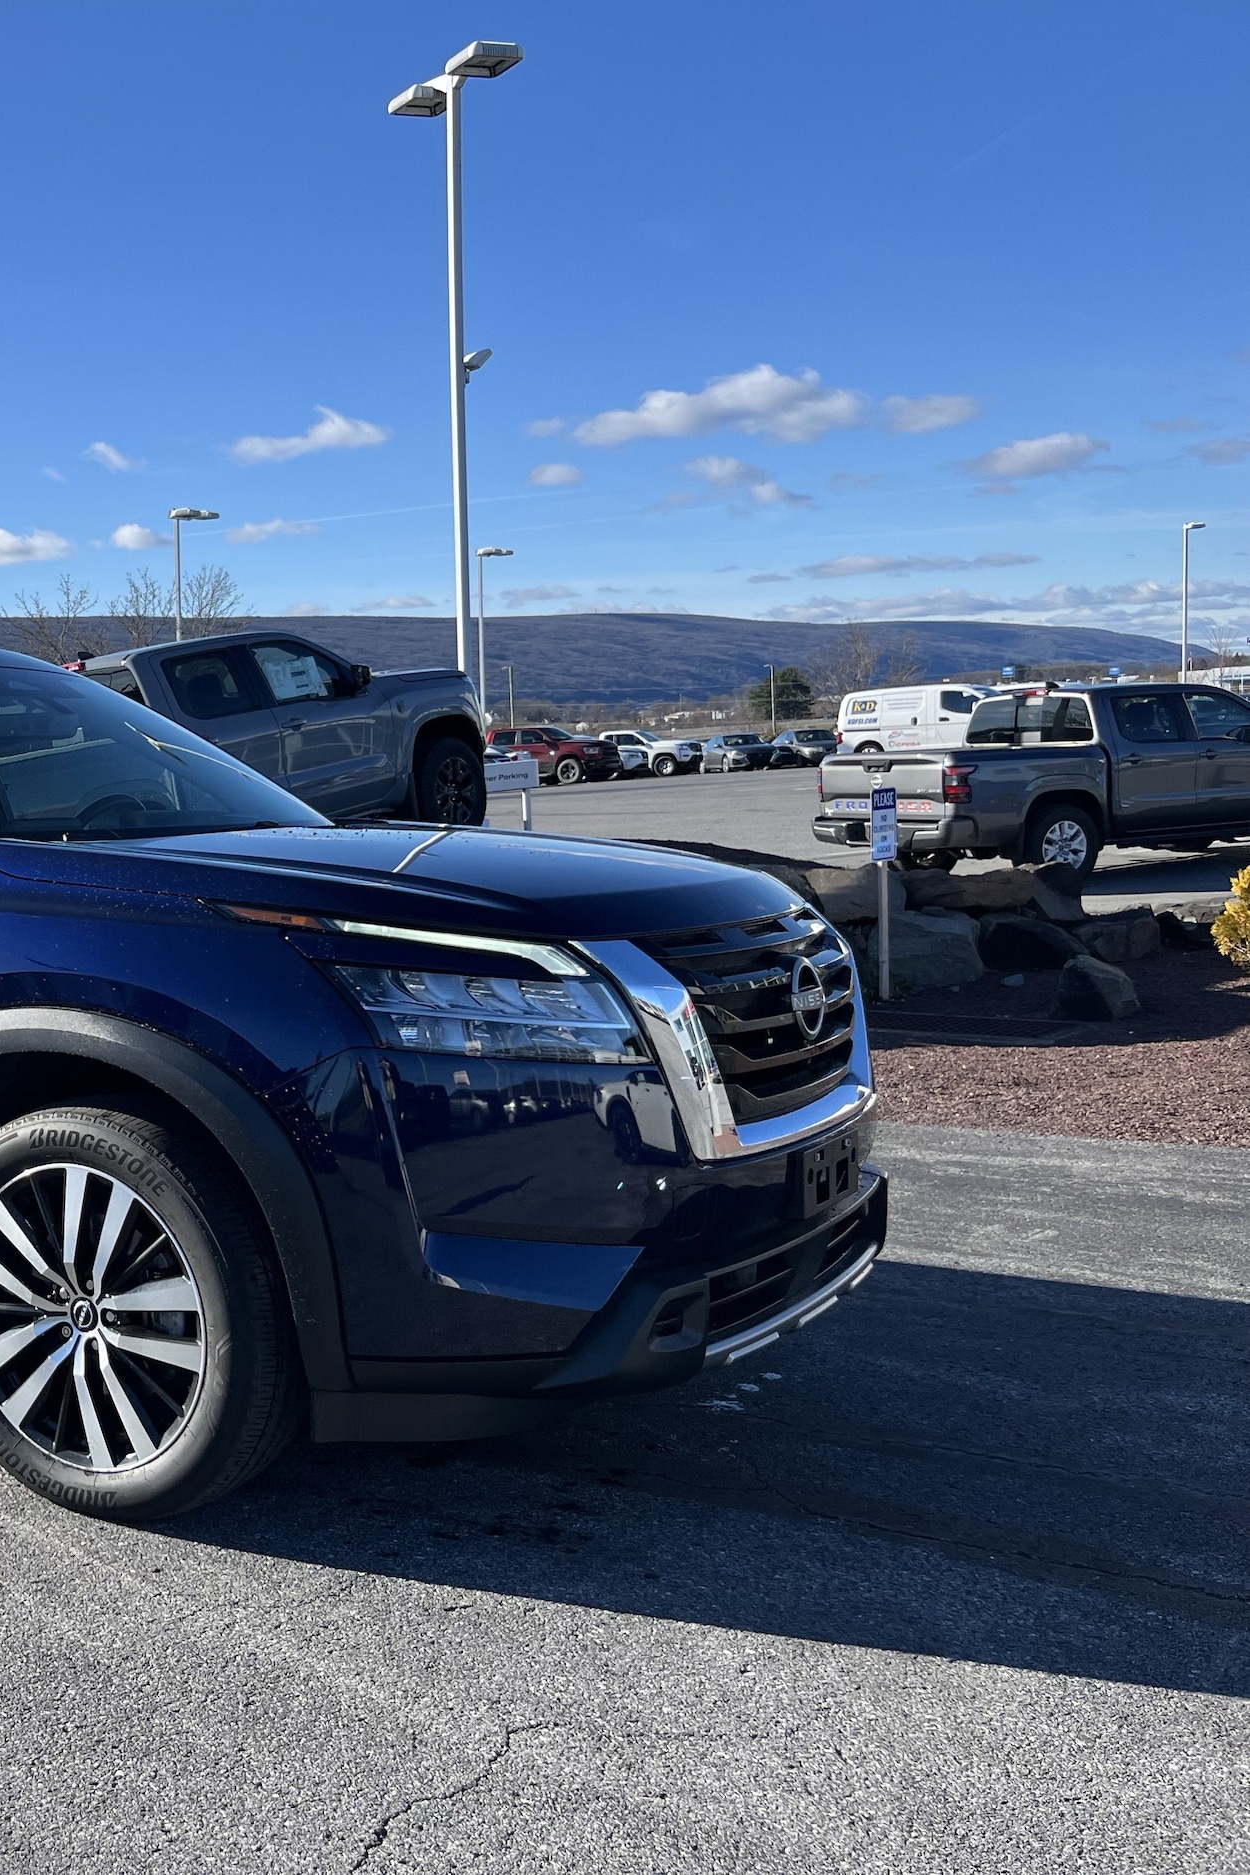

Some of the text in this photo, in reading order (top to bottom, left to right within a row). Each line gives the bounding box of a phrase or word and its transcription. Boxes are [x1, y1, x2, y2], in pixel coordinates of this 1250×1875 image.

[498, 772, 529, 780] Parking
[873, 791, 895, 807] PLEASE
[834, 801, 933, 812] FROIER
[880, 814, 888, 822] NO
[880, 835, 888, 843] ON
[28, 1127, 170, 1197] BRIDGESTONE
